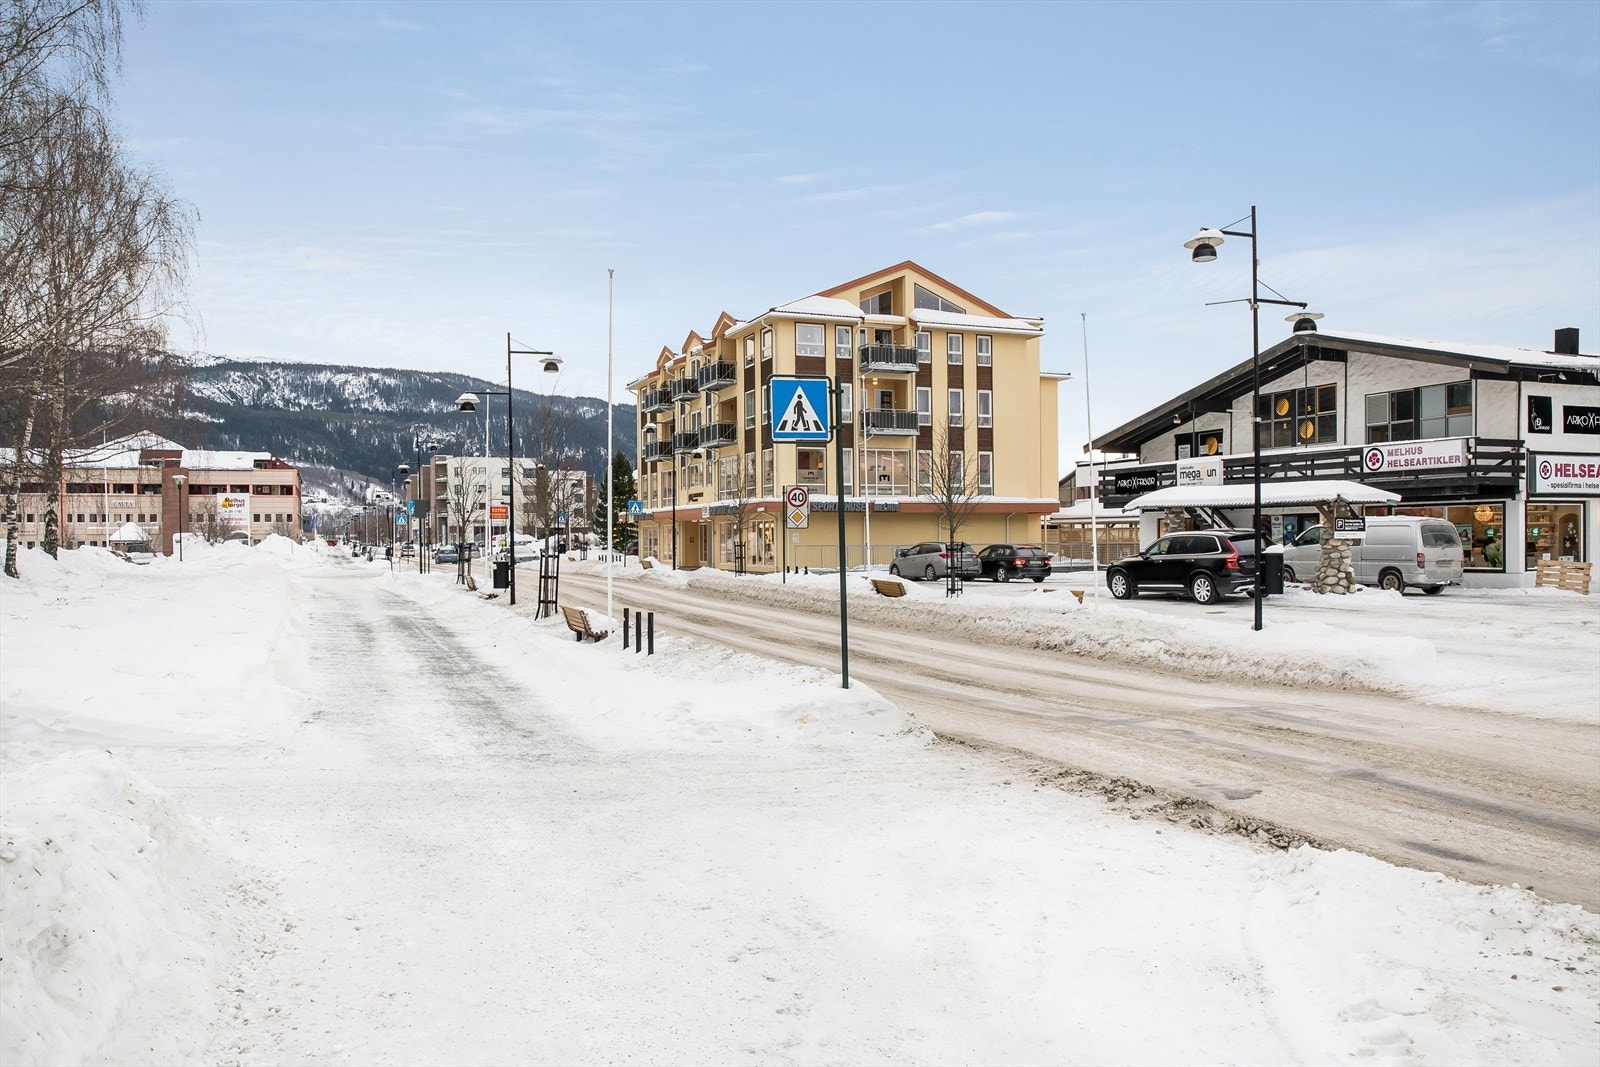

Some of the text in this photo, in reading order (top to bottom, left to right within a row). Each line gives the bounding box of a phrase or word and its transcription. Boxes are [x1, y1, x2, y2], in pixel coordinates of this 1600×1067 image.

[1387, 446, 1423, 457] MELHUS
[1387, 455, 1461, 468] HELSEARTIKLER
[1179, 467, 1217, 481] megaun
[1550, 482, 1582, 490] spesialfirma
[791, 492, 804, 503] 40
